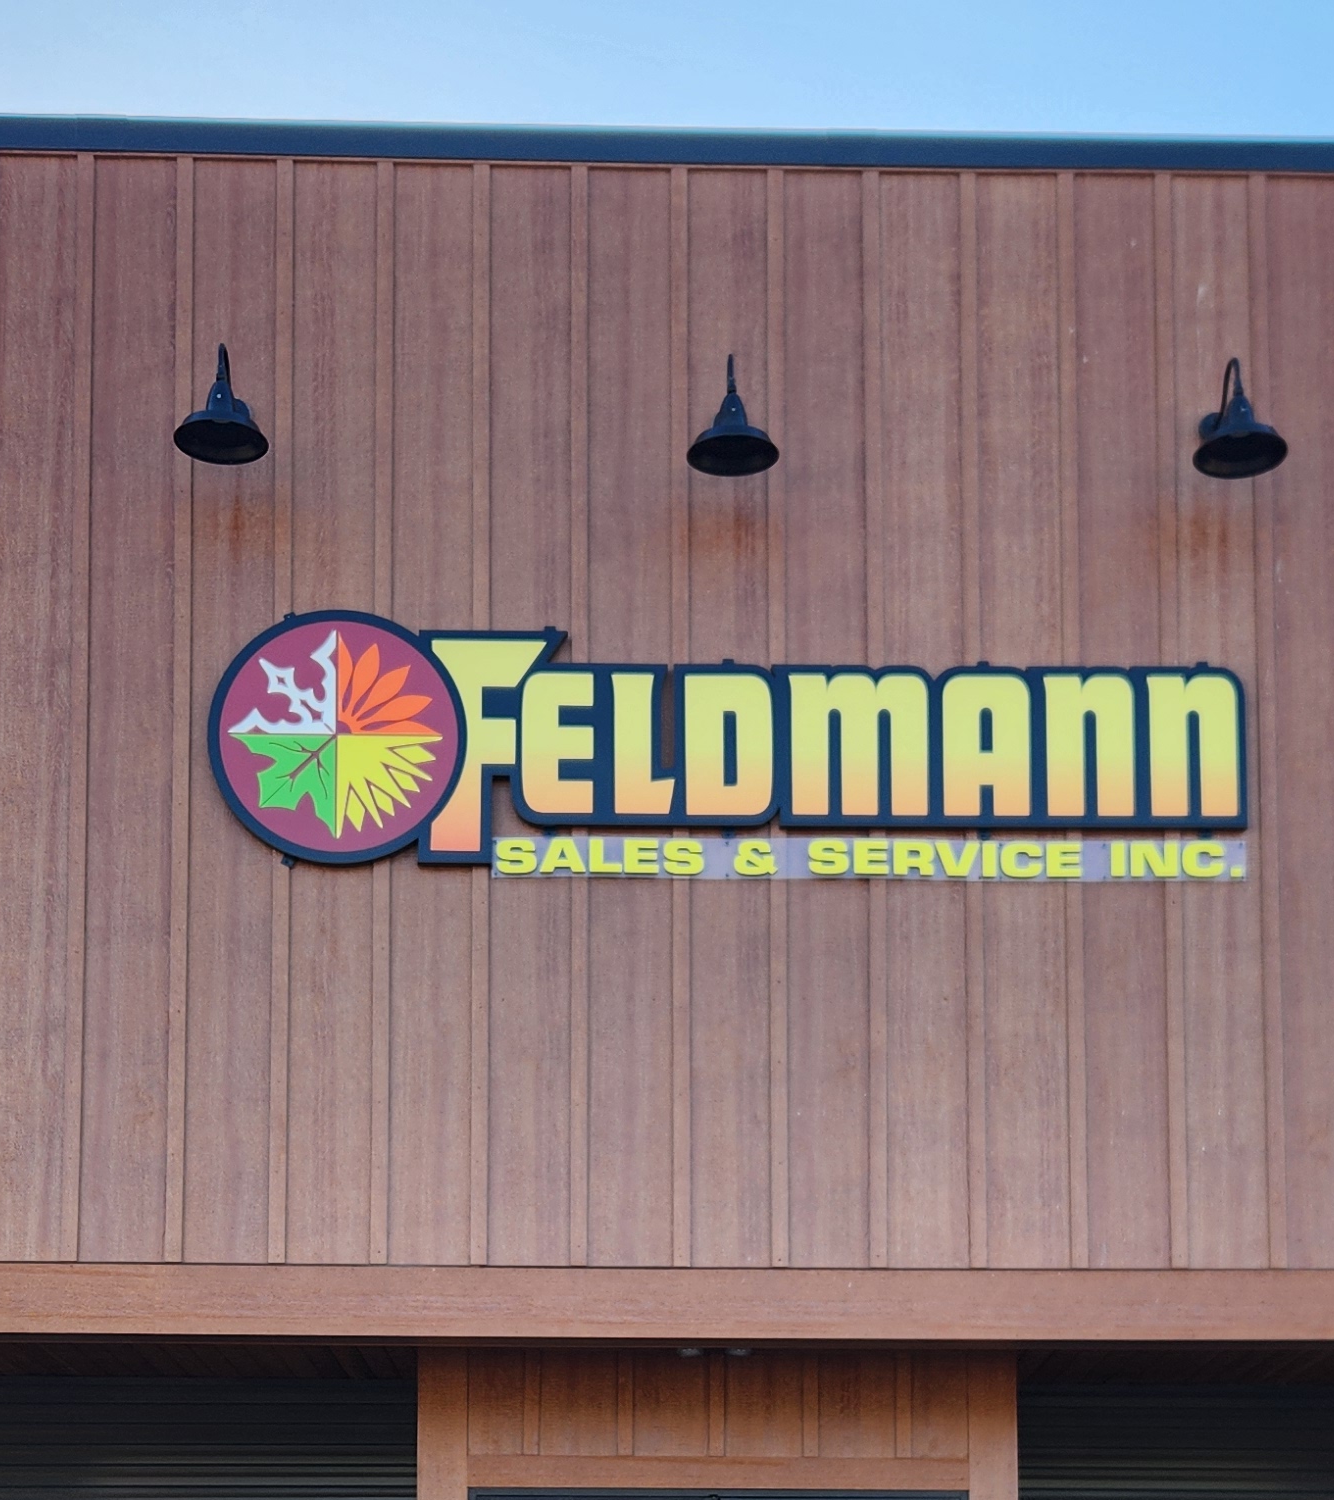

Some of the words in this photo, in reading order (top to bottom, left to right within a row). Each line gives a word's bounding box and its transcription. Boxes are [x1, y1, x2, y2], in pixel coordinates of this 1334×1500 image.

[429, 638, 1242, 853] FELDMANN
[495, 838, 706, 877] SALES
[733, 838, 778, 877] &
[807, 838, 1083, 877] SERVICE
[1110, 839, 1245, 878] INC.
